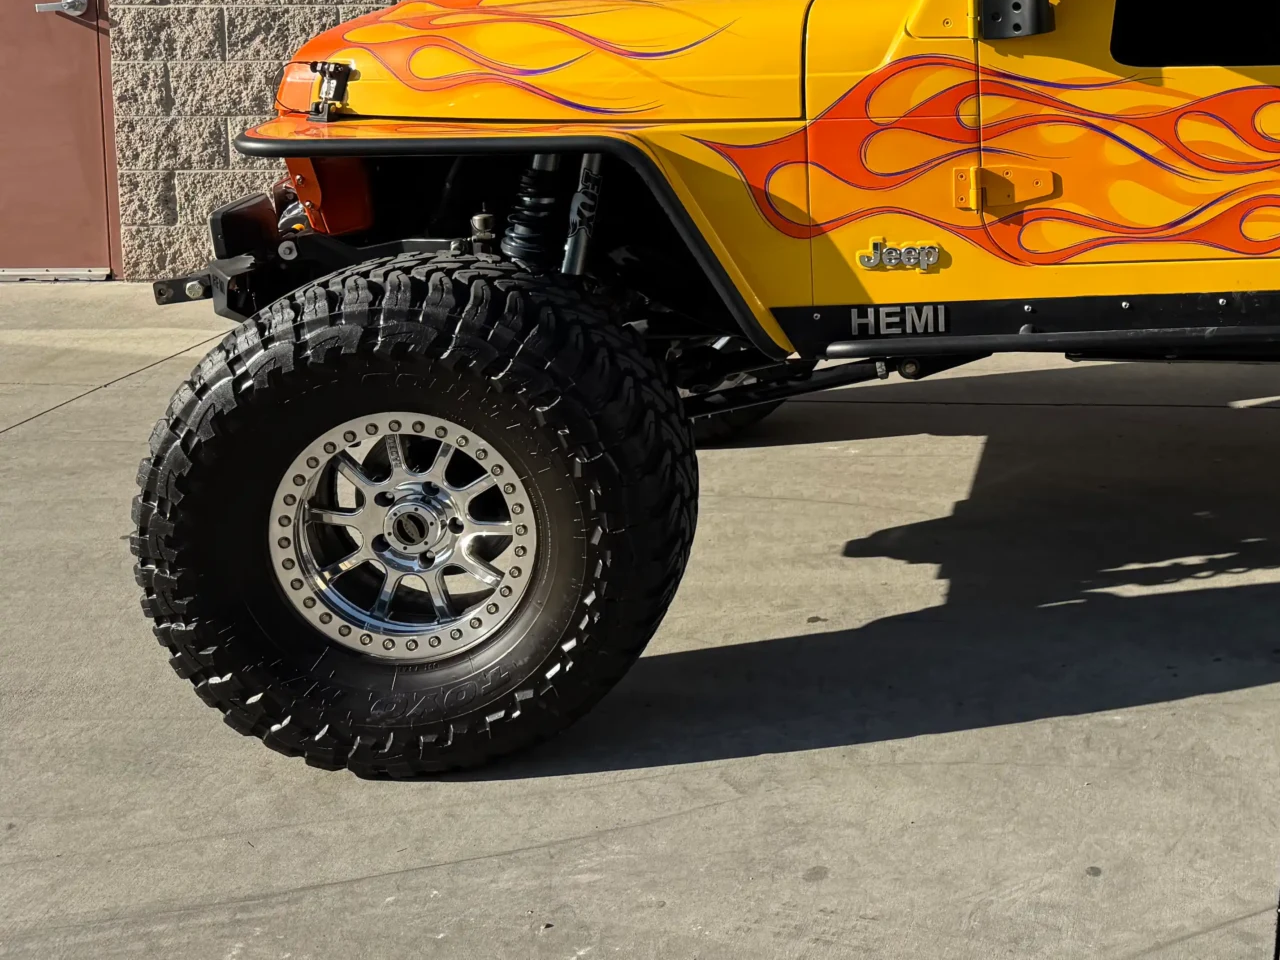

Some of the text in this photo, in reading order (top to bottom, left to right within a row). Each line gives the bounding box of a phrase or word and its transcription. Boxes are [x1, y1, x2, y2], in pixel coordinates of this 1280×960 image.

[569, 168, 603, 239] FOX
[859, 241, 940, 270] Jeep
[851, 304, 945, 335] HEMI
[369, 665, 511, 719] TOYO
